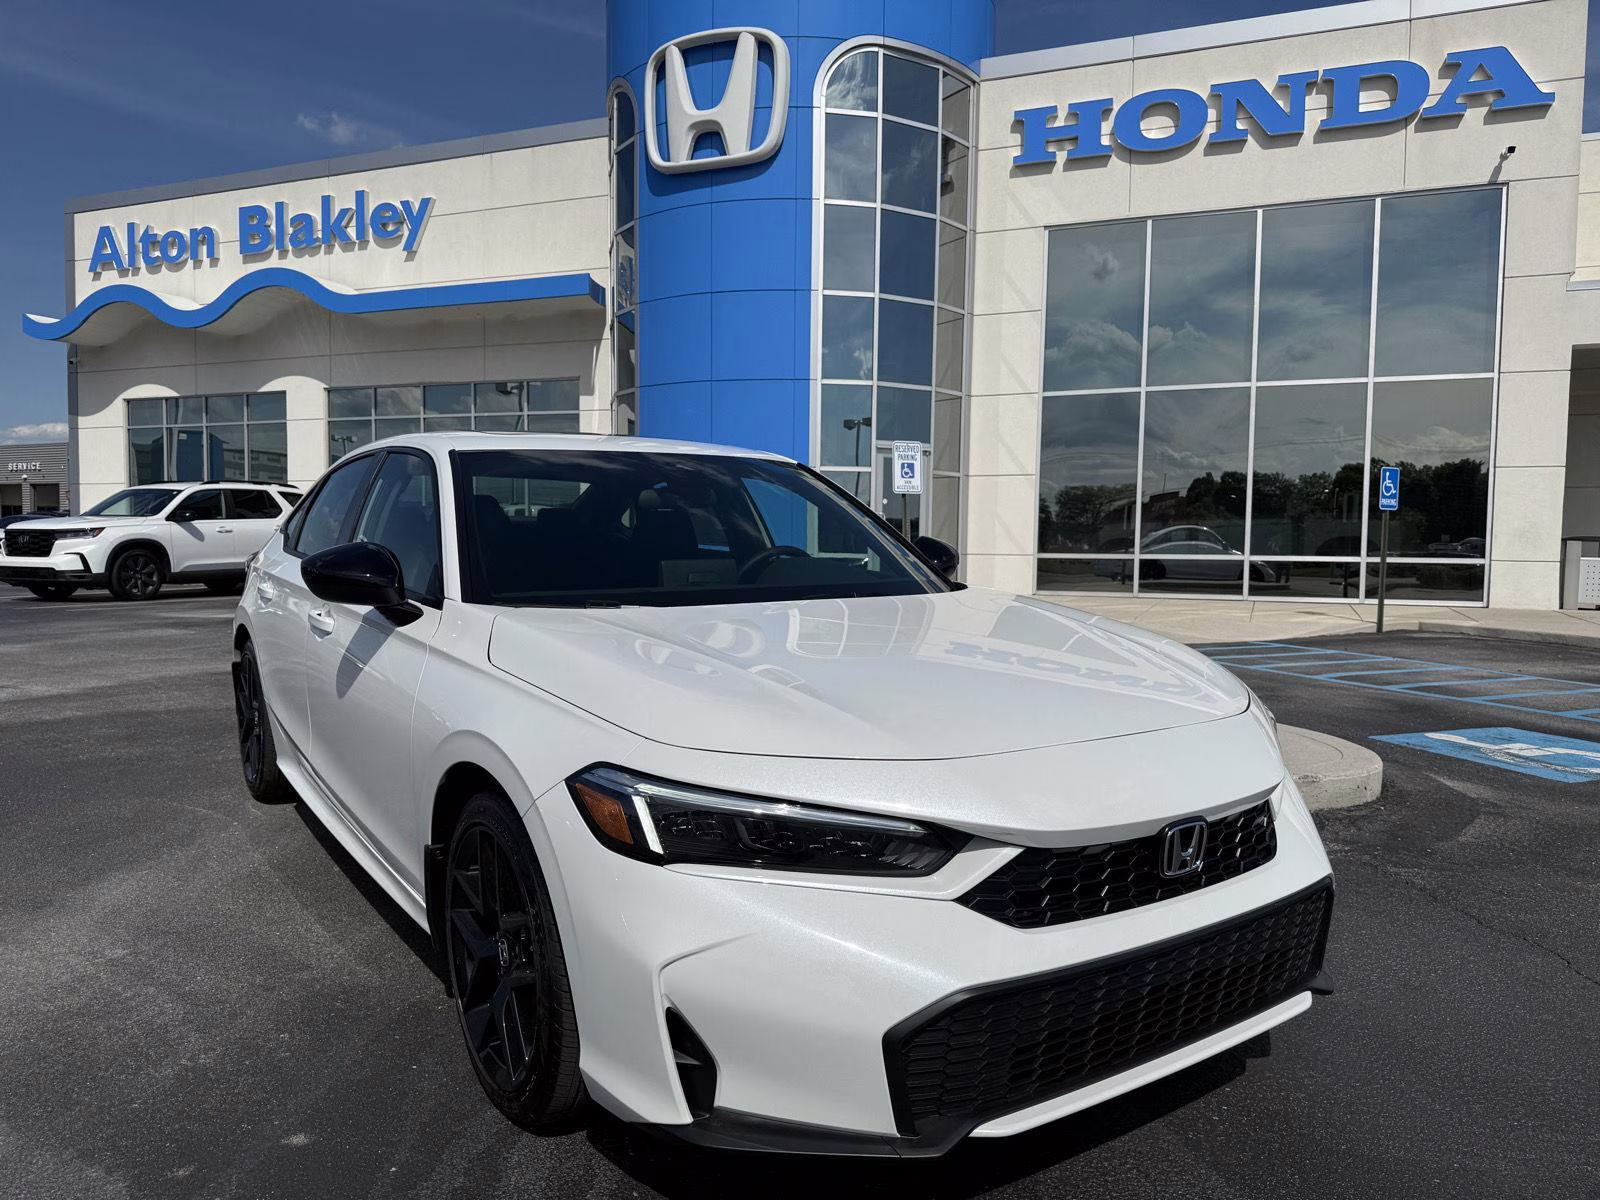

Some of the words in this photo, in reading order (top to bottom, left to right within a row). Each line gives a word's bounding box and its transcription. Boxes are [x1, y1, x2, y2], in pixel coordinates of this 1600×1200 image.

[1013, 46, 1556, 166] HONDA
[88, 221, 219, 273] Alton
[238, 189, 435, 255] Blakley
[895, 444, 920, 454] RESERVED
[897, 453, 918, 462] PARKING
[8, 462, 42, 471] SERVICE
